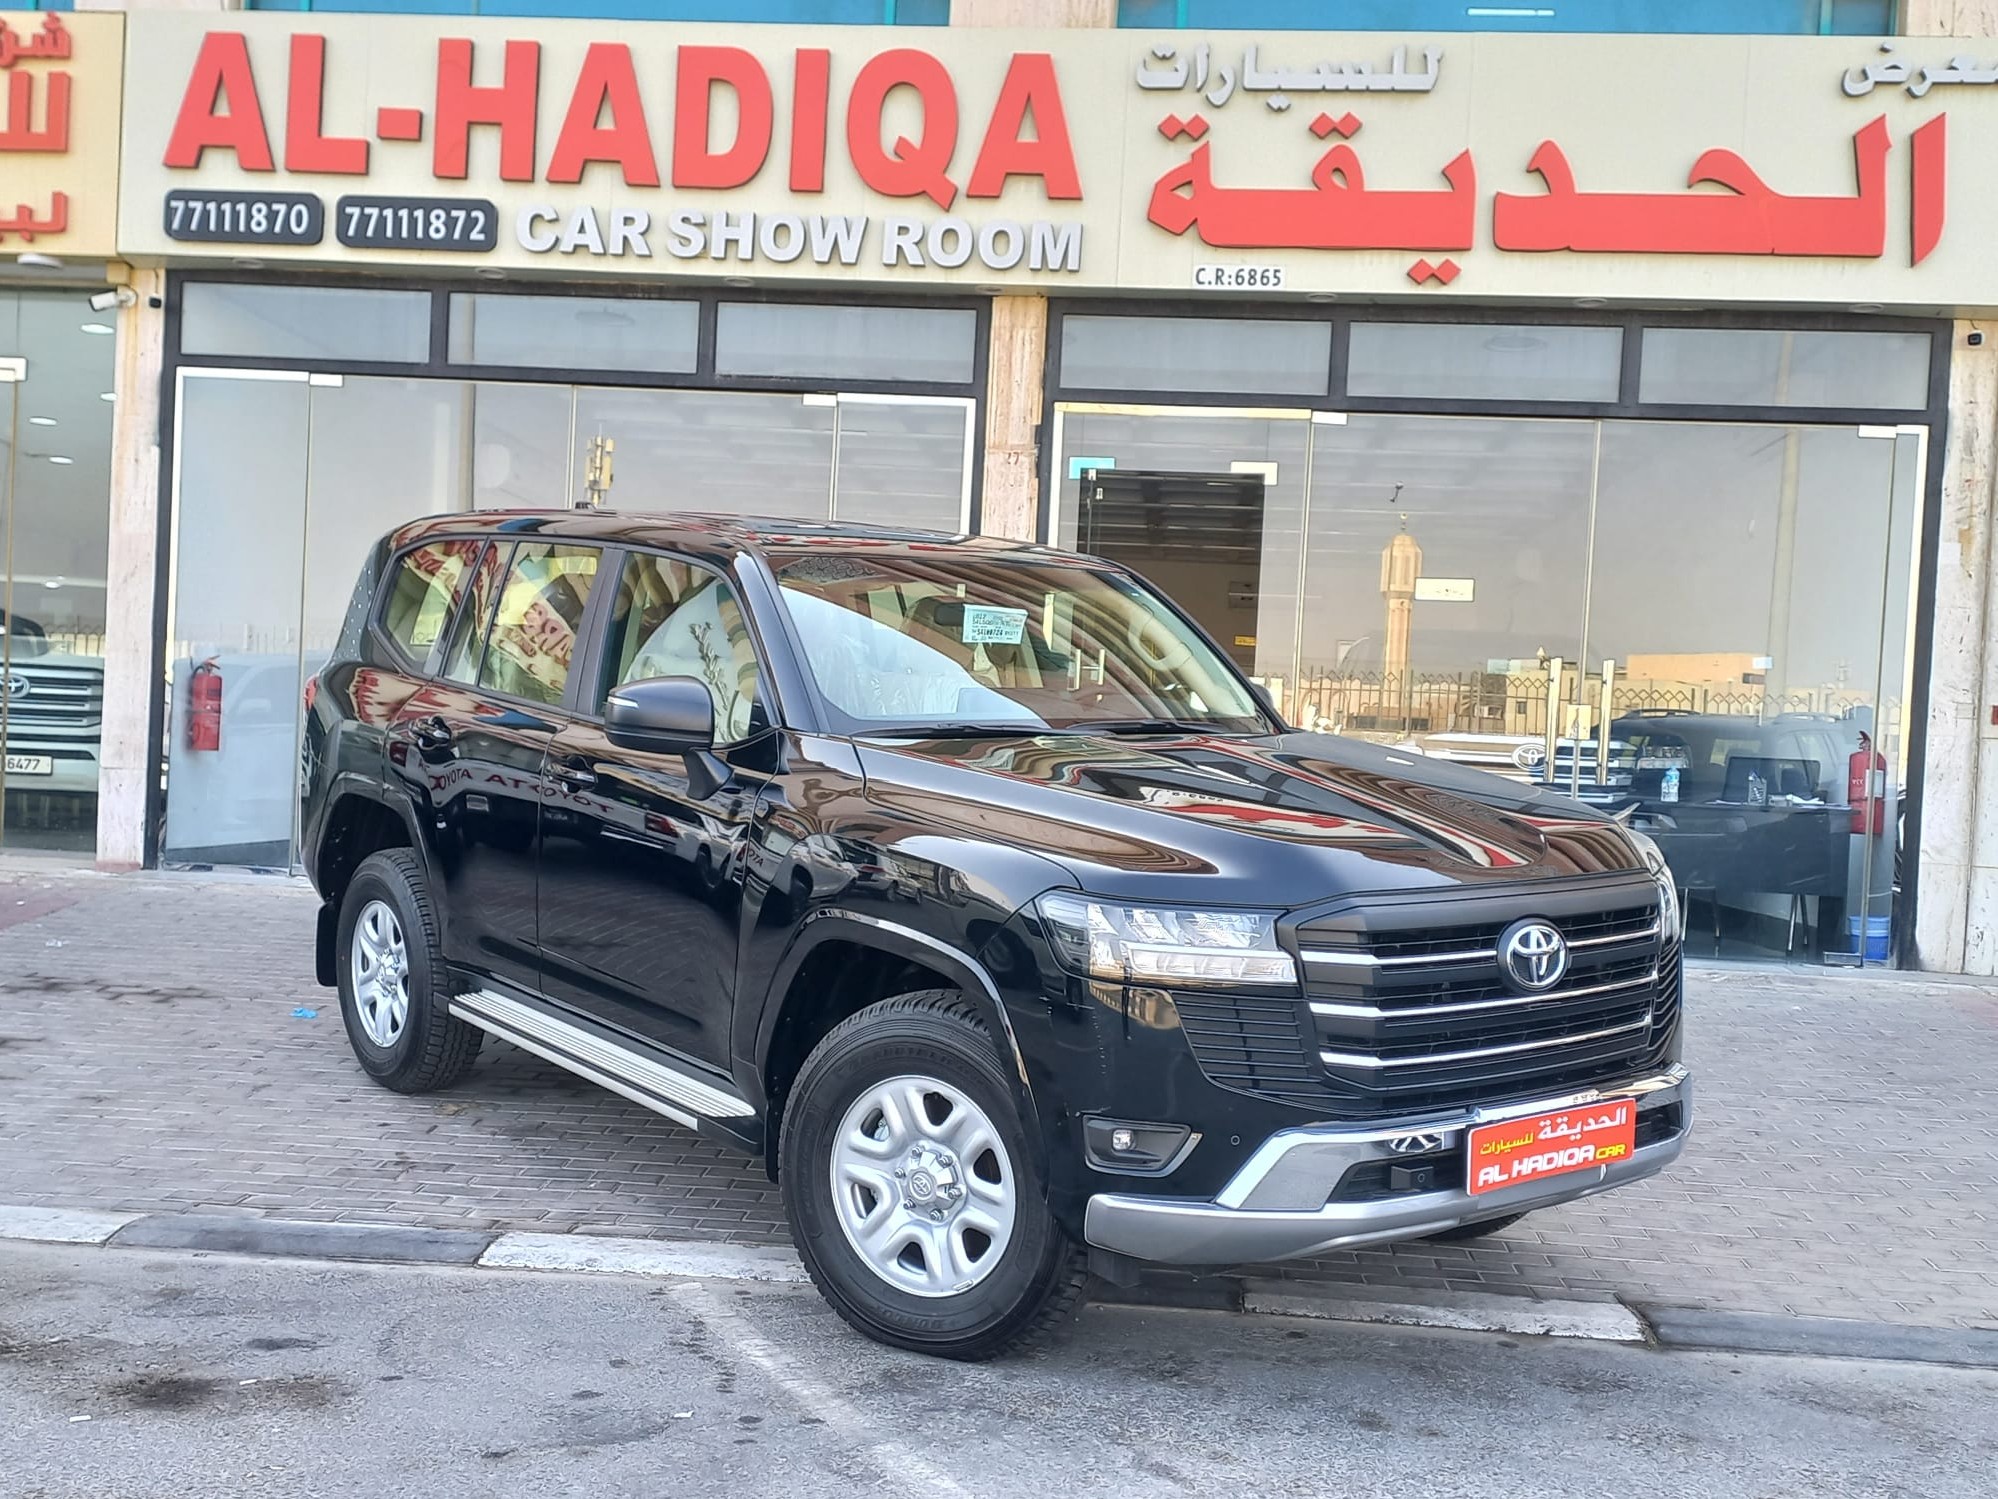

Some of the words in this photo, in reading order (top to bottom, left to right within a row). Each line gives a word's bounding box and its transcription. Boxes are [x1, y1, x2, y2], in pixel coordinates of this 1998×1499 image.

[1137, 44, 1440, 111] للسيارات
[1841, 41, 1998, 98] عرض
[164, 31, 1083, 211] AL-HADIQA
[170, 200, 309, 234] 77111870
[1147, 112, 1947, 285] الحديقة
[345, 206, 485, 241] 77111872
[516, 206, 652, 256] CAR
[669, 208, 867, 264] SHOW
[882, 217, 1083, 271] ROOM
[1195, 267, 1281, 286] C.R:6865
[1480, 1132, 1534, 1156] للسيارات
[1537, 1106, 1627, 1142] الحديقة
[1477, 1164, 1509, 1188] AL
[1511, 1144, 1597, 1179] HADIQA
[1595, 1143, 1626, 1160] CAR
